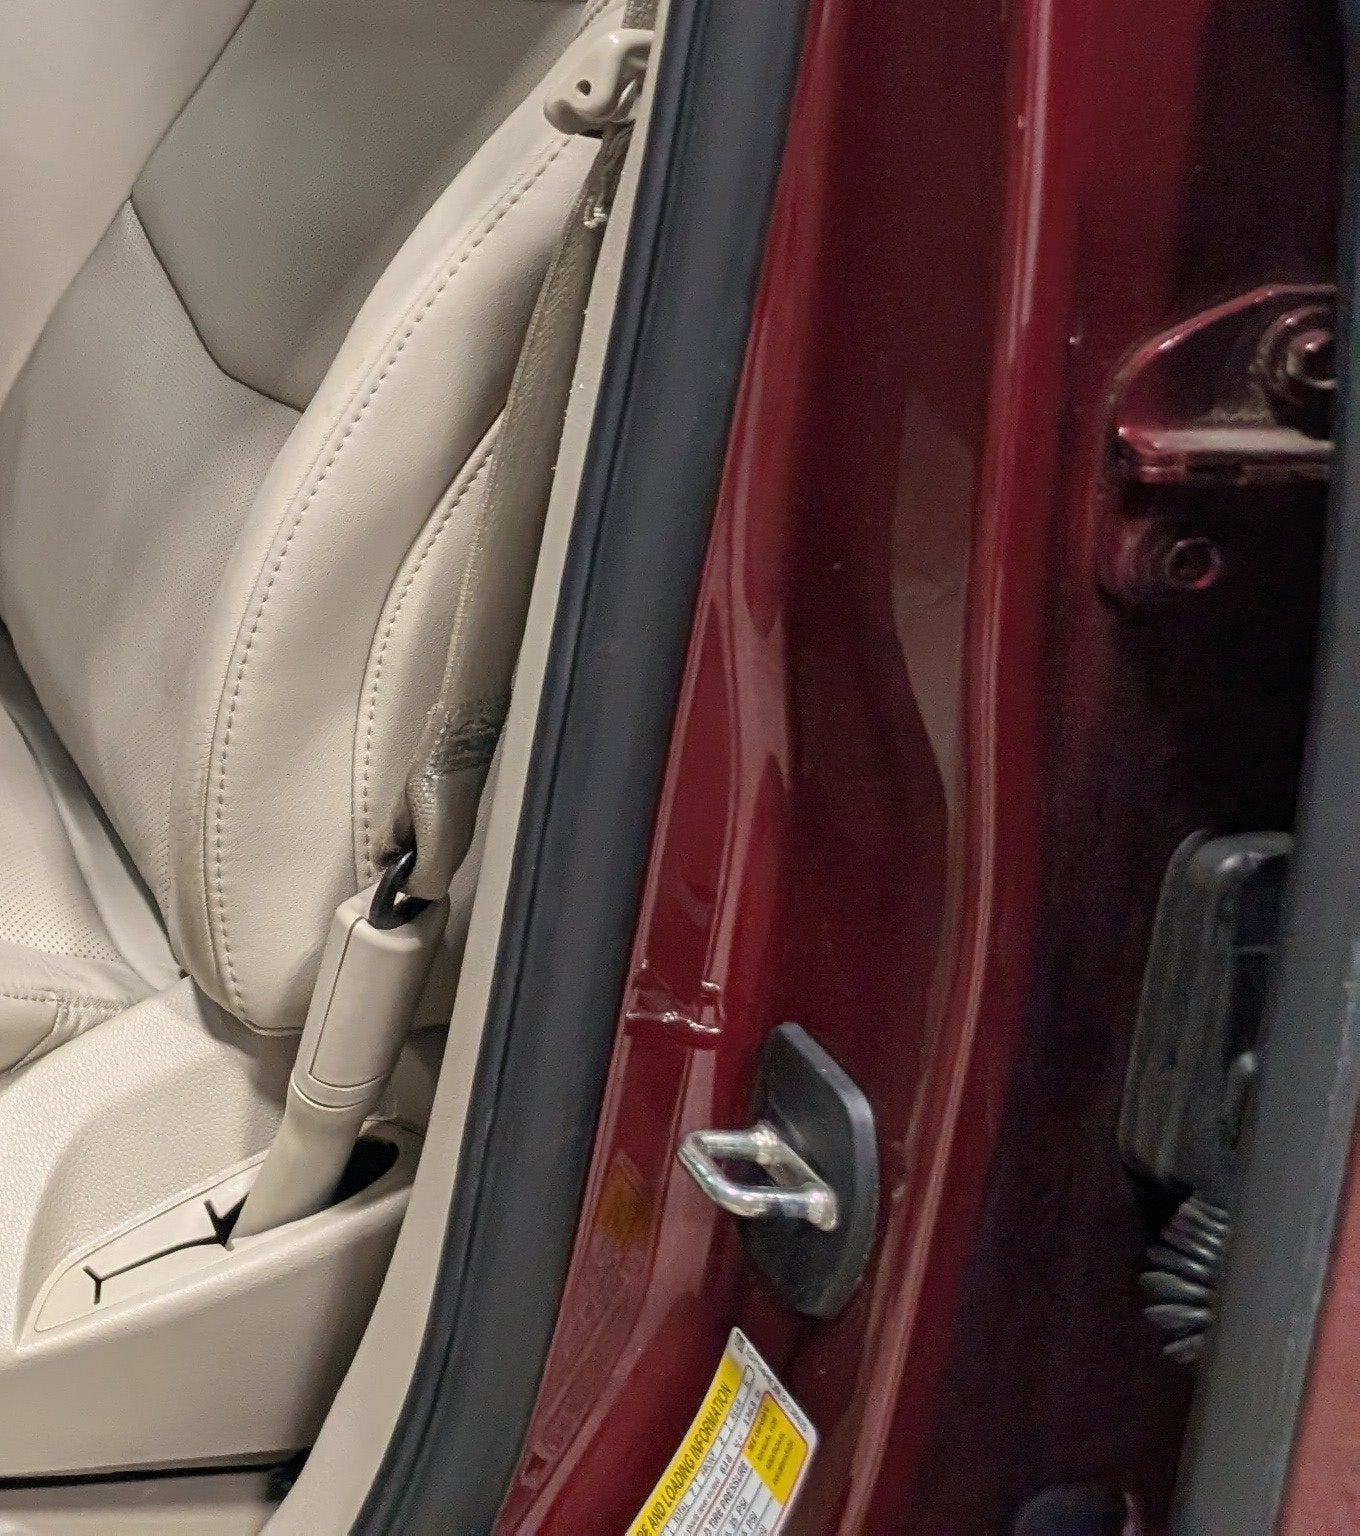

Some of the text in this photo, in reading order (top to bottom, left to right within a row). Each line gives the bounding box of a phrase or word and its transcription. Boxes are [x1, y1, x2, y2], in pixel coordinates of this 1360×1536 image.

[647, 1501, 666, 1531] AND
[660, 1453, 696, 1508] LOADING
[689, 1381, 732, 1461] INFORMATION
